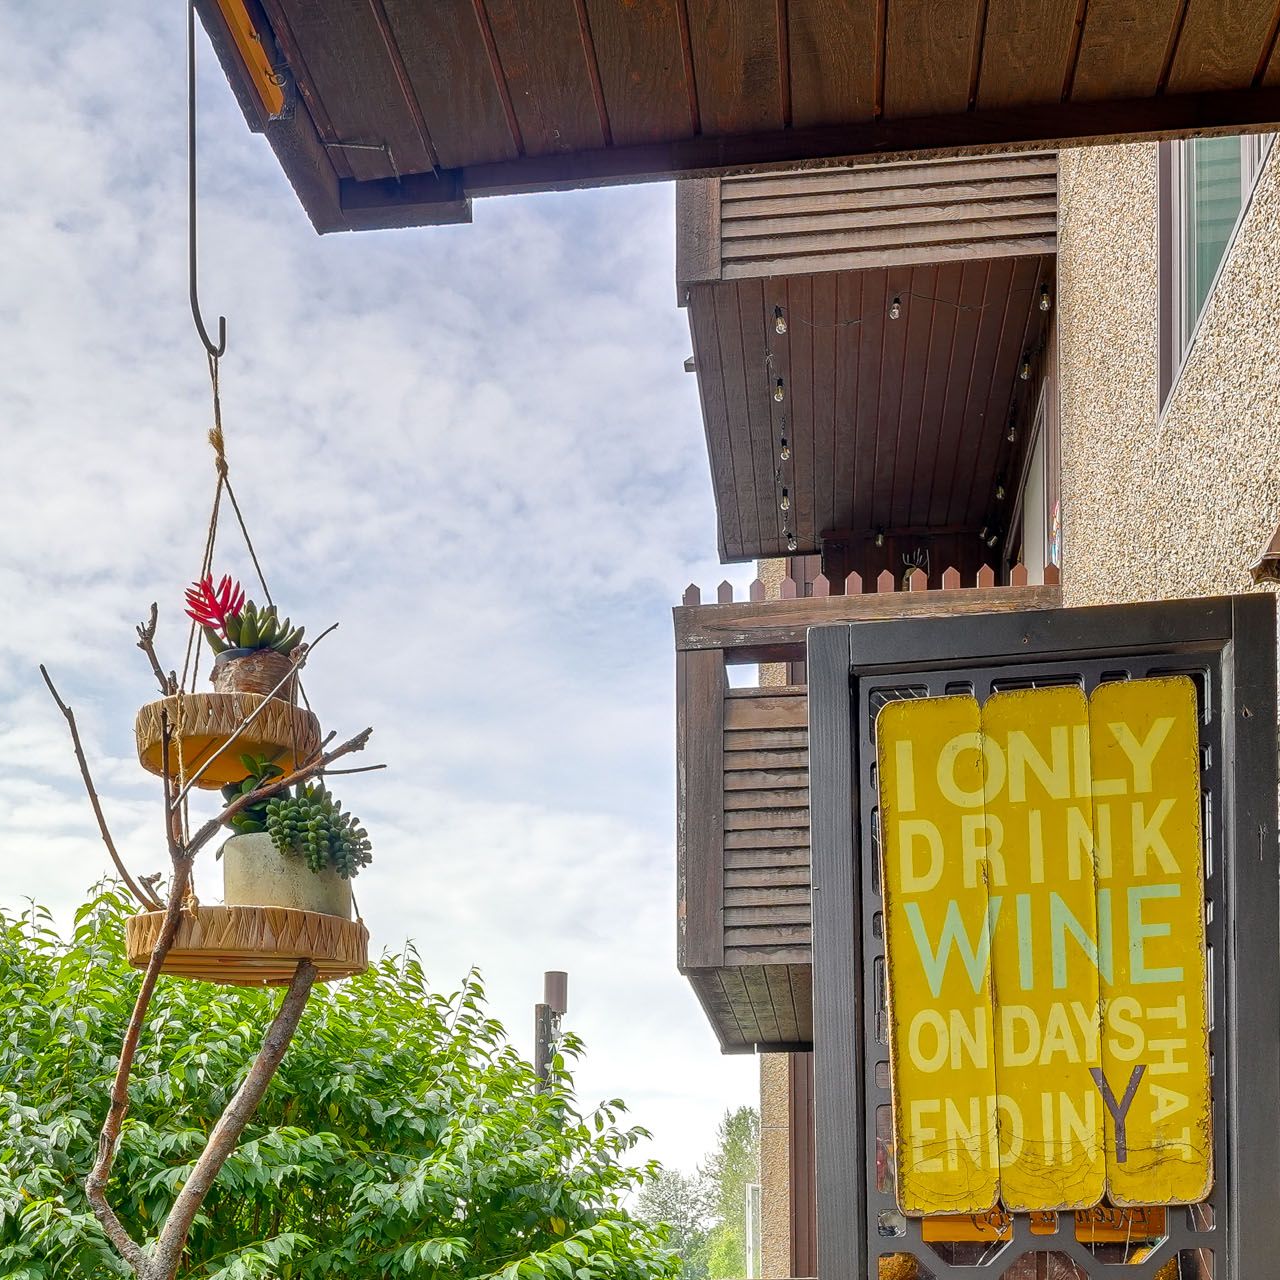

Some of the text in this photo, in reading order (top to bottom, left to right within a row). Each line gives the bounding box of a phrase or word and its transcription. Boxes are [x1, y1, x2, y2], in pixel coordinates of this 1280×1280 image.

[895, 717, 1177, 812] I ONLY
[899, 798, 1182, 894] DRINK
[904, 883, 1184, 999] WINE
[908, 996, 1145, 1073] ON DAYS
[1148, 998, 1192, 1161] THAT
[910, 1064, 1146, 1174] END IN Y
